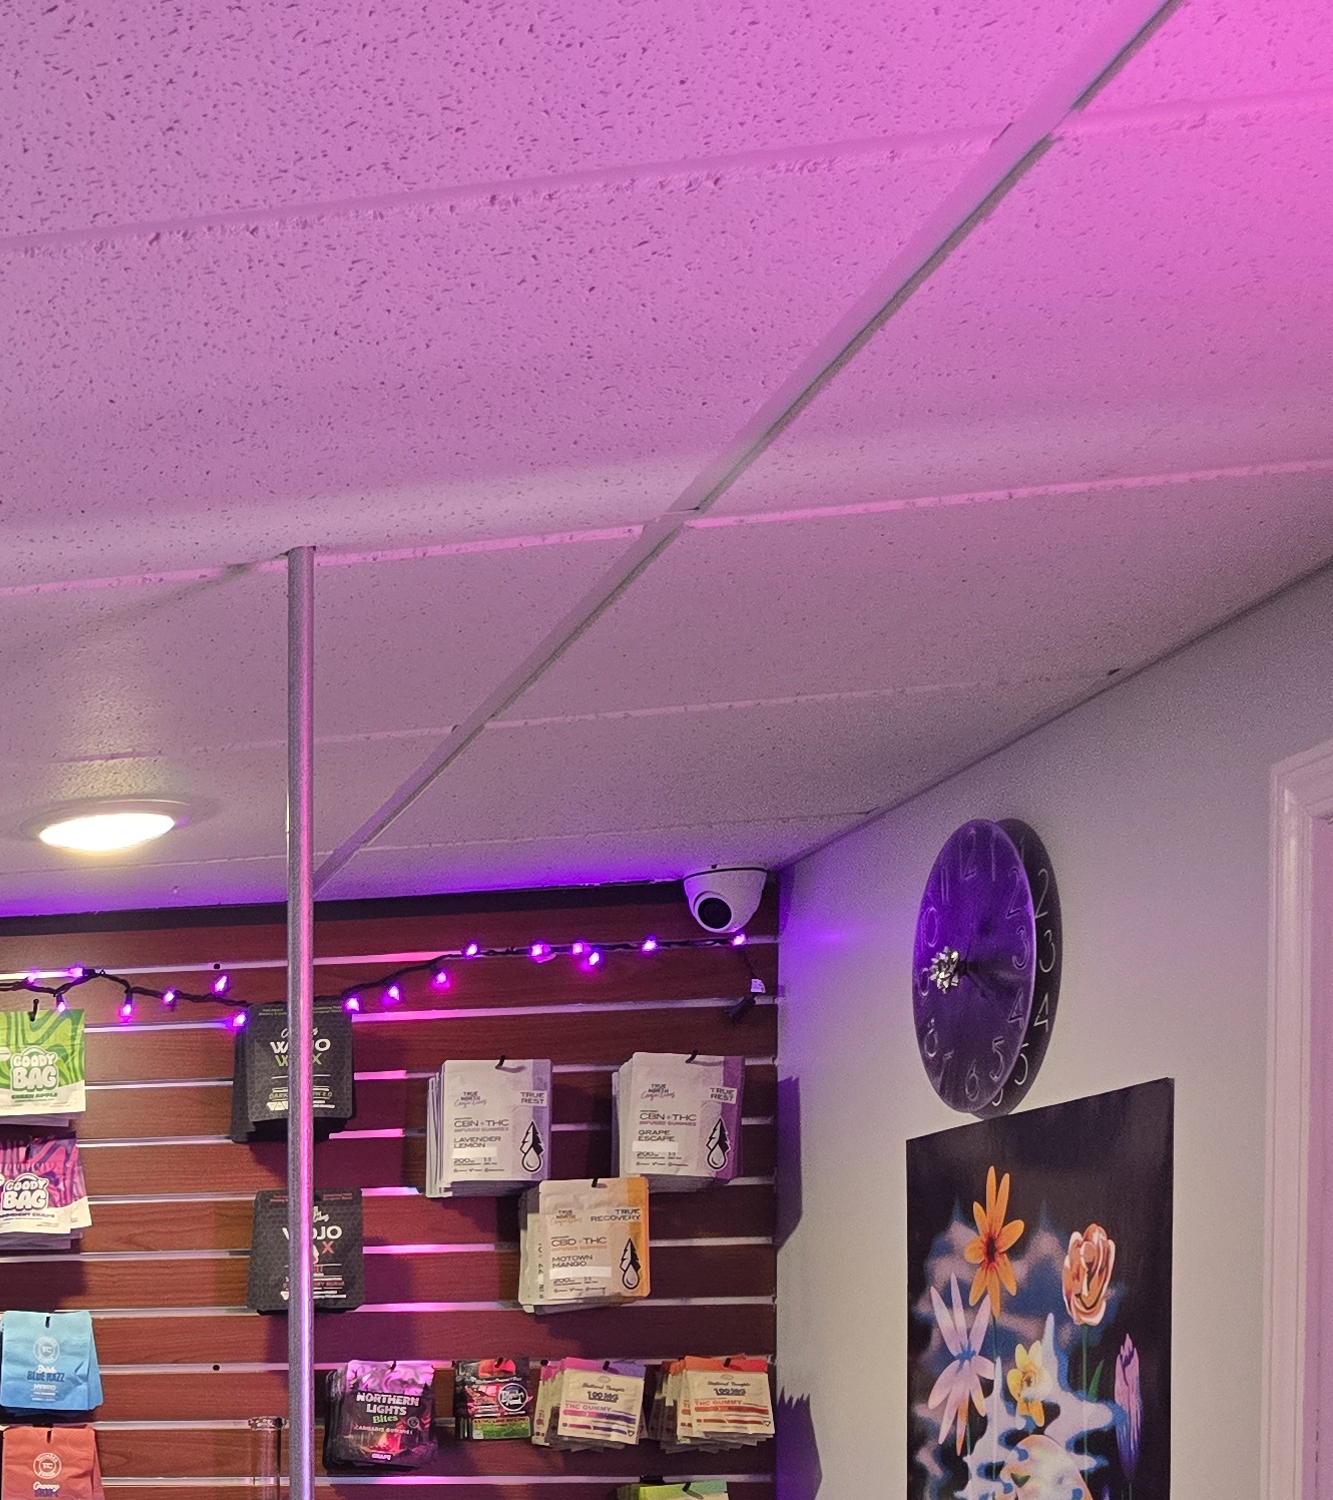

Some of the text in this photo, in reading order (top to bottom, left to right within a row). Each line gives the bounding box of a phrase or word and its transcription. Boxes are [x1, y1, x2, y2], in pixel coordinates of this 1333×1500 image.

[12, 1066, 58, 1089] BAG
[356, 1392, 419, 1407] NORTHERN
[366, 1404, 407, 1417] LIGHTS
